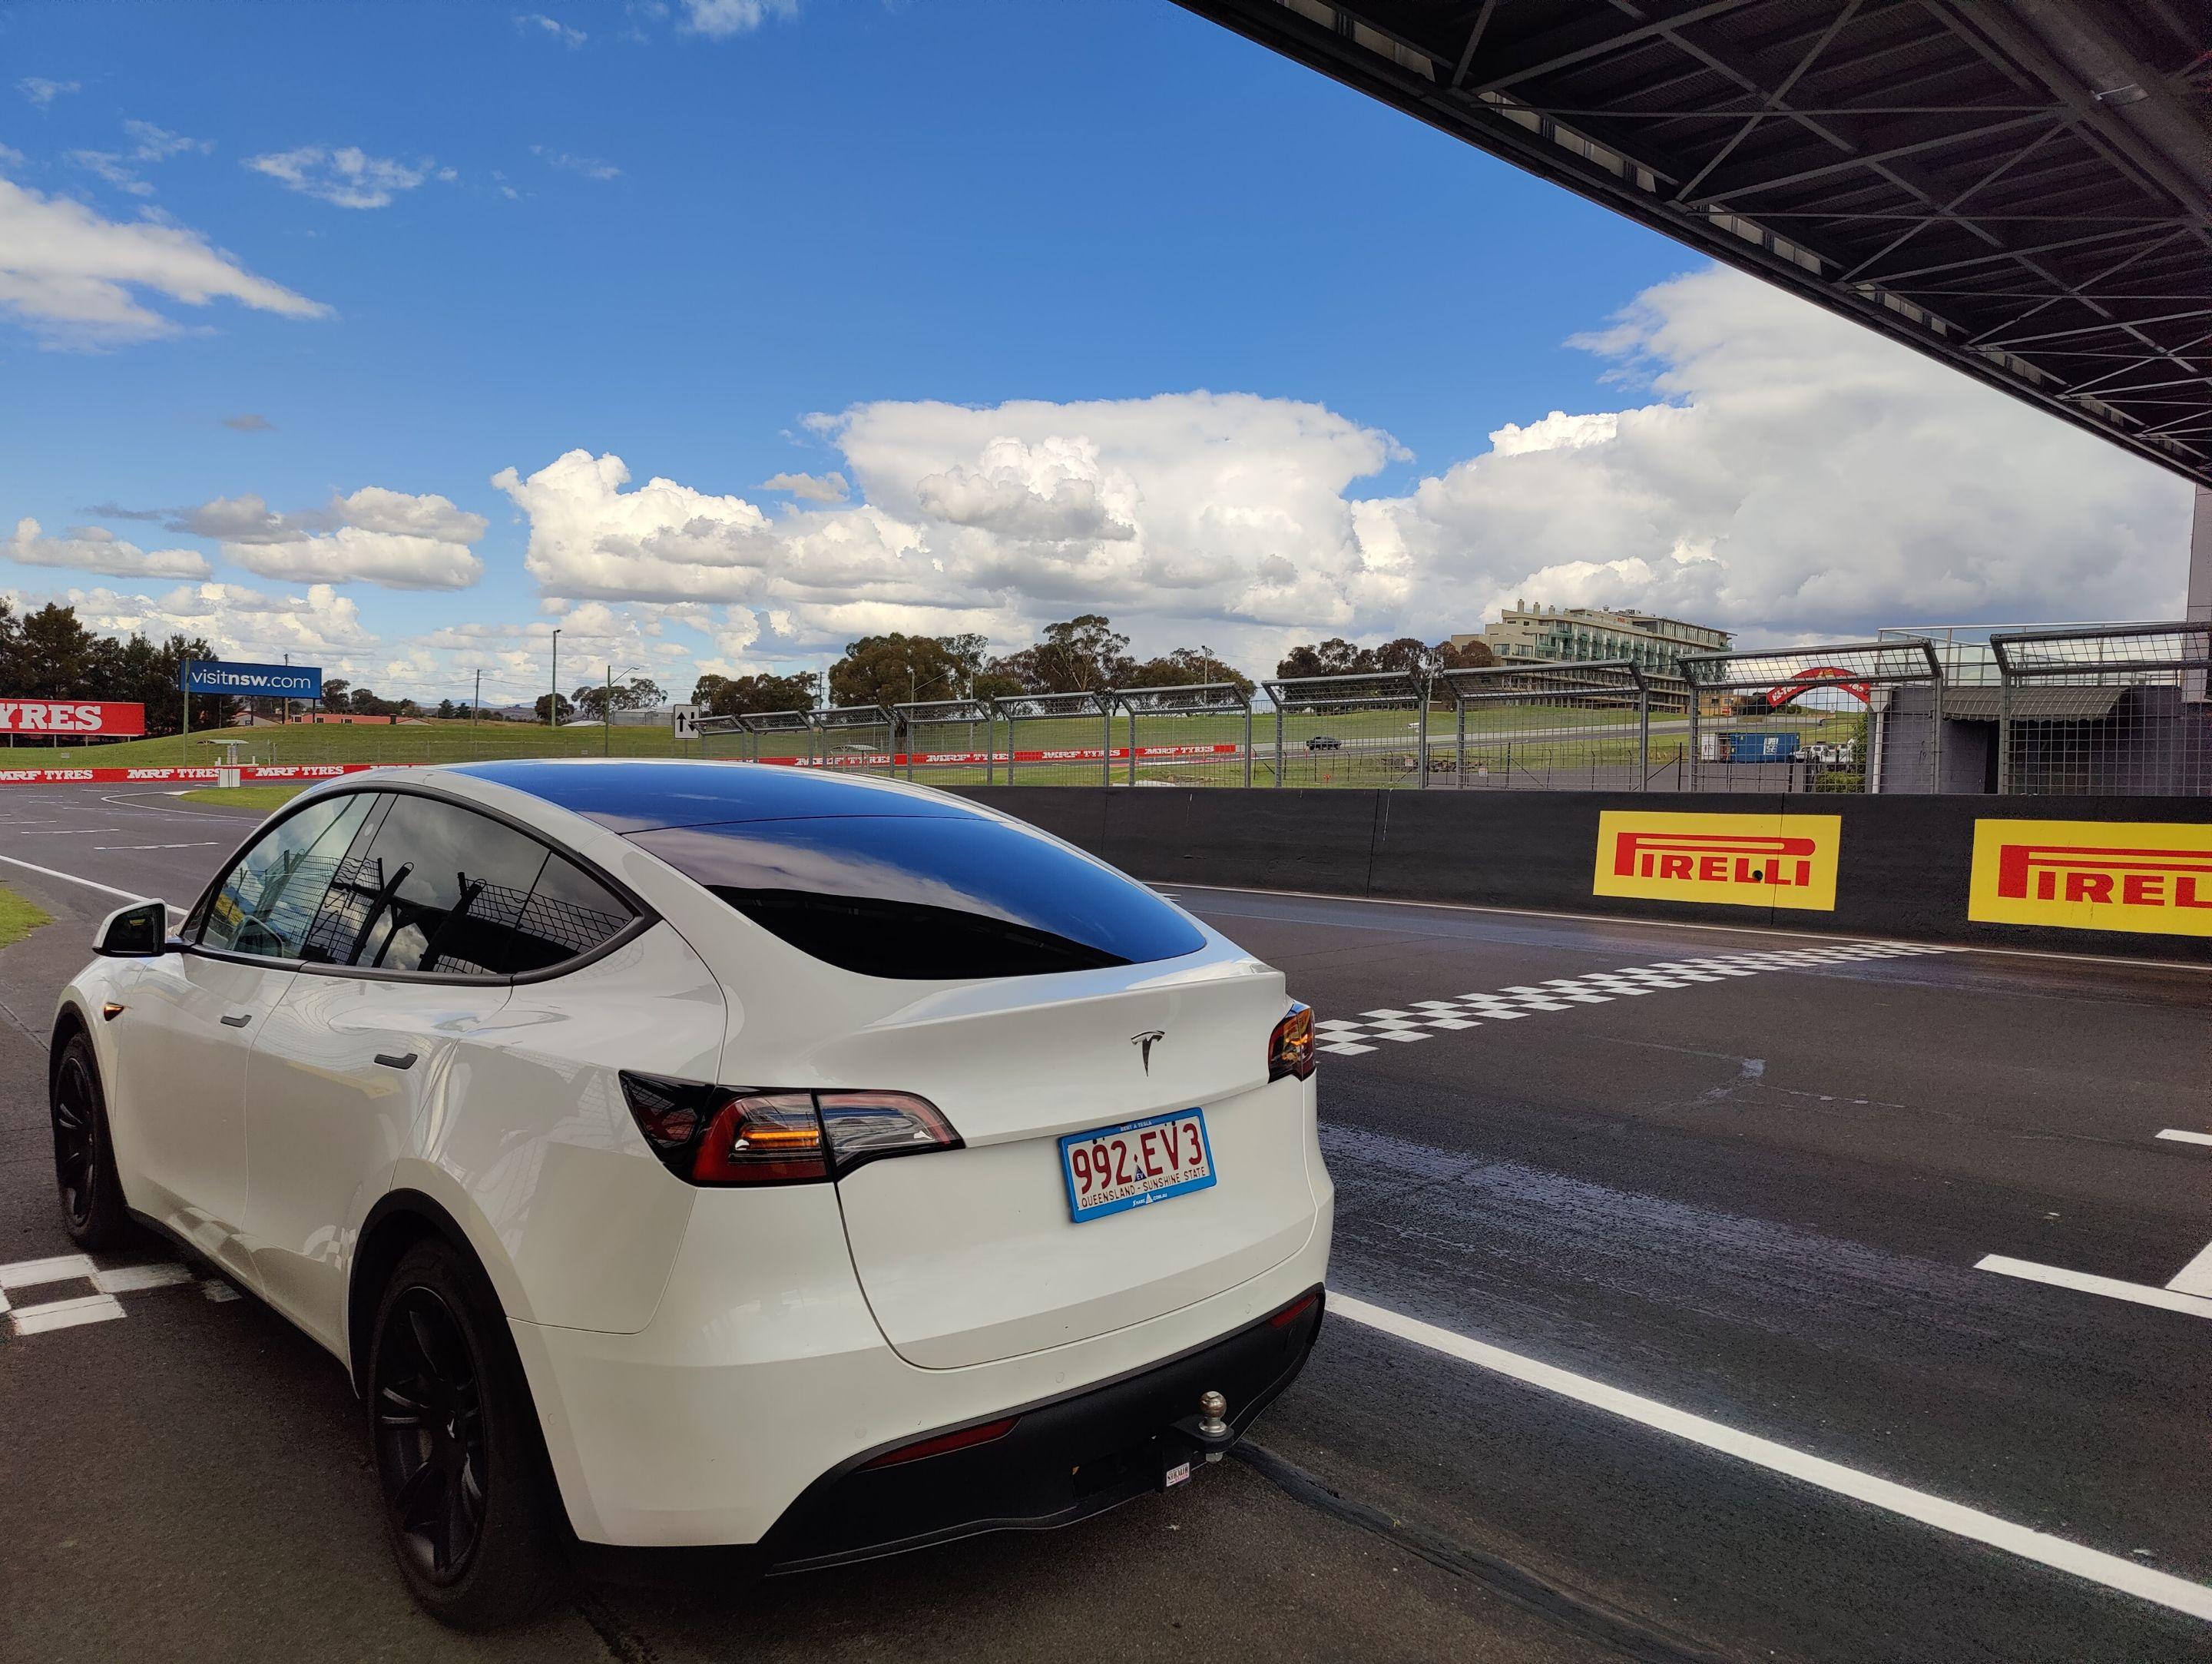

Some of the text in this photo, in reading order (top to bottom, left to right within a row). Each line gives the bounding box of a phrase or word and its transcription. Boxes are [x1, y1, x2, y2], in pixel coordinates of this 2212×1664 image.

[192, 668, 311, 689] visitnsw.com
[0, 769, 93, 781] MRF TYRES
[127, 768, 175, 779] MRF
[256, 765, 344, 777] MRF TYRES
[1614, 832, 1816, 887] PIRELLI
[1081, 1185, 1135, 1208] QUEENSLAND
[1143, 1175, 1181, 1192] SUNSHINE
[1185, 1166, 1206, 1181] STATE
